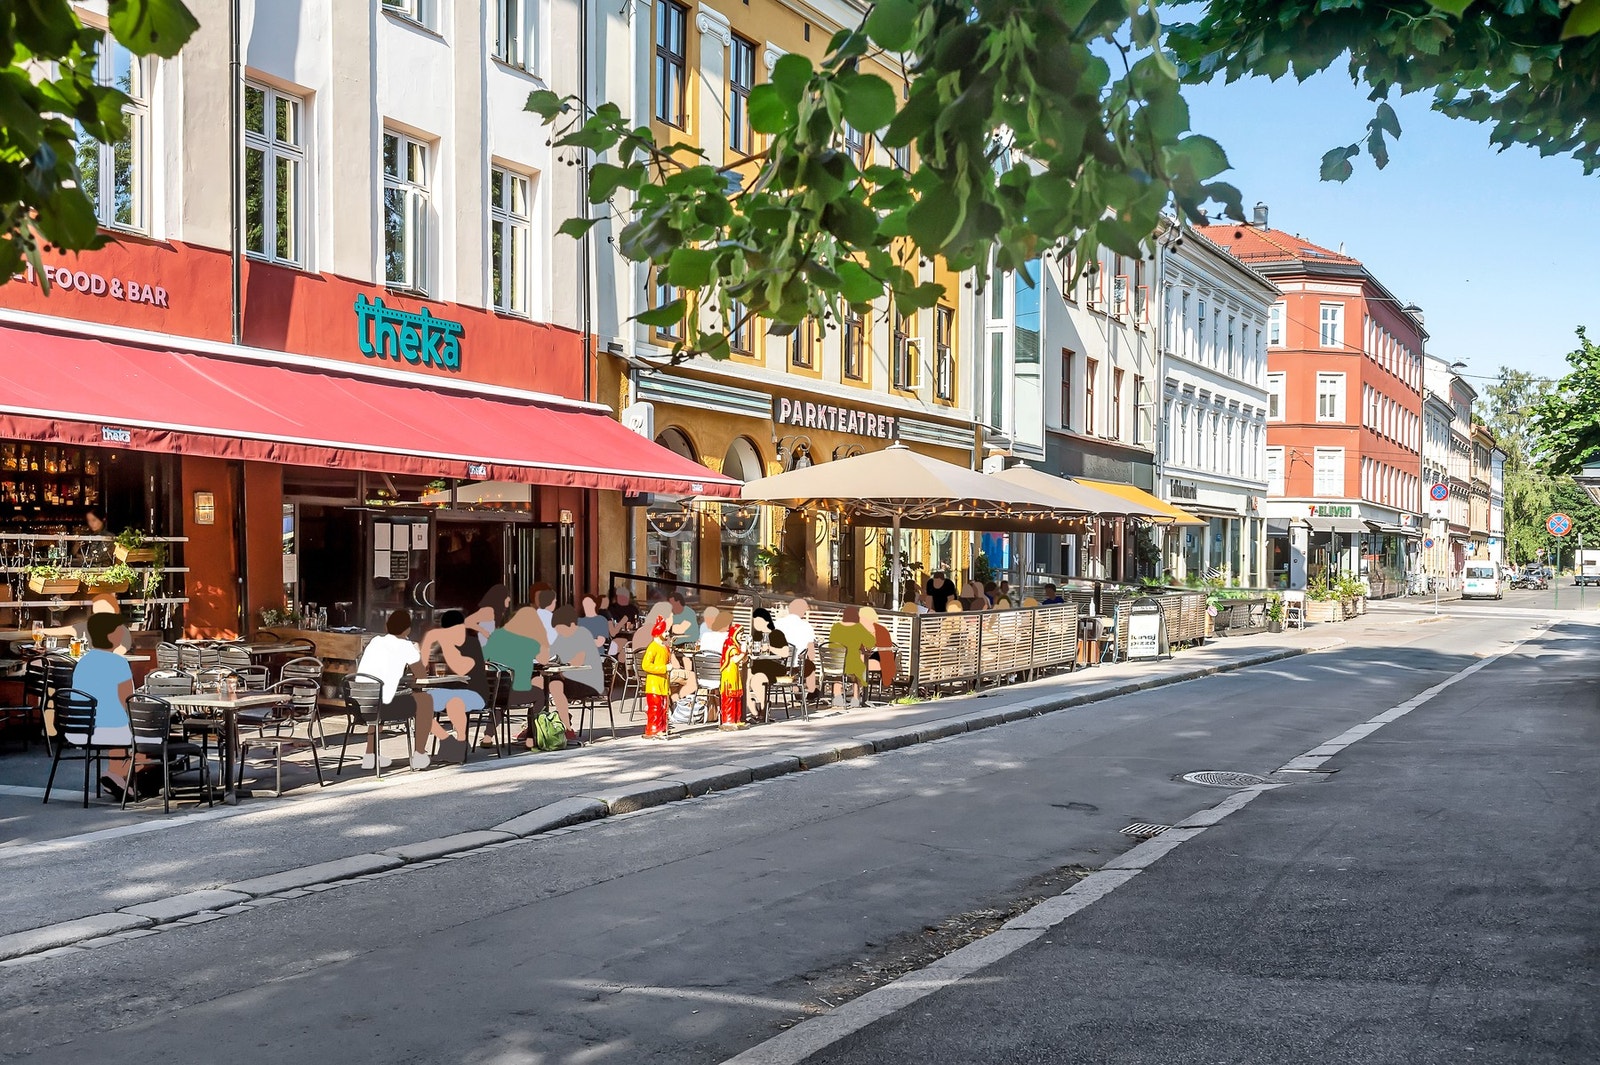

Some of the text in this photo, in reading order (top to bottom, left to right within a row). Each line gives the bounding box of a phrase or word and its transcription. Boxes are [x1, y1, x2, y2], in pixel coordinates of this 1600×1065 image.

[43, 264, 107, 296] FOOD
[110, 277, 125, 300] &
[127, 280, 168, 308] BAR
[354, 293, 463, 369] theka
[102, 425, 131, 443] theka
[779, 397, 895, 439] PARKTEATRET
